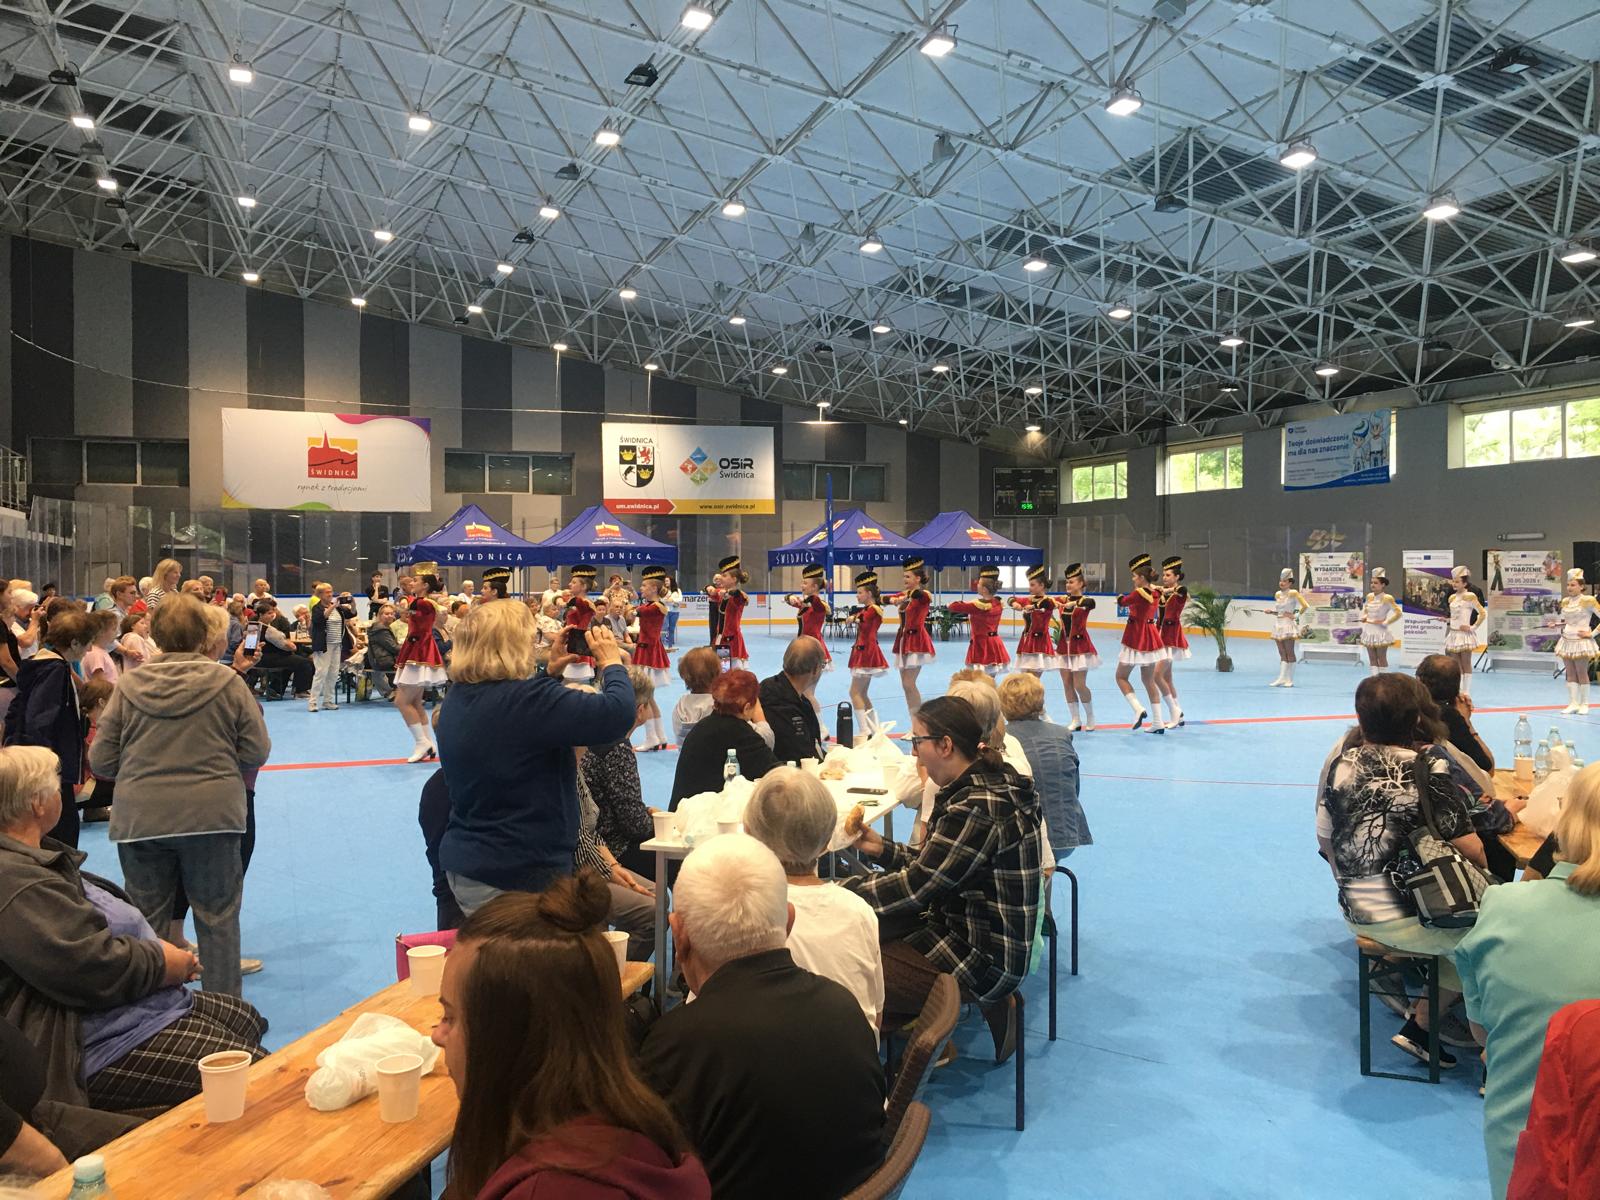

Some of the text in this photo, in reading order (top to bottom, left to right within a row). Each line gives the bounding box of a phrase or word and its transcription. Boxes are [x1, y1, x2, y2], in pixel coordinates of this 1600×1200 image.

[719, 458, 754, 469] OSiR
[310, 468, 356, 476] ŚWIDNICA
[448, 552, 522, 560] ŚWIDNICA
[580, 552, 651, 560] ŚWIDNICA
[962, 553, 1020, 562] ŚWIDNICA
